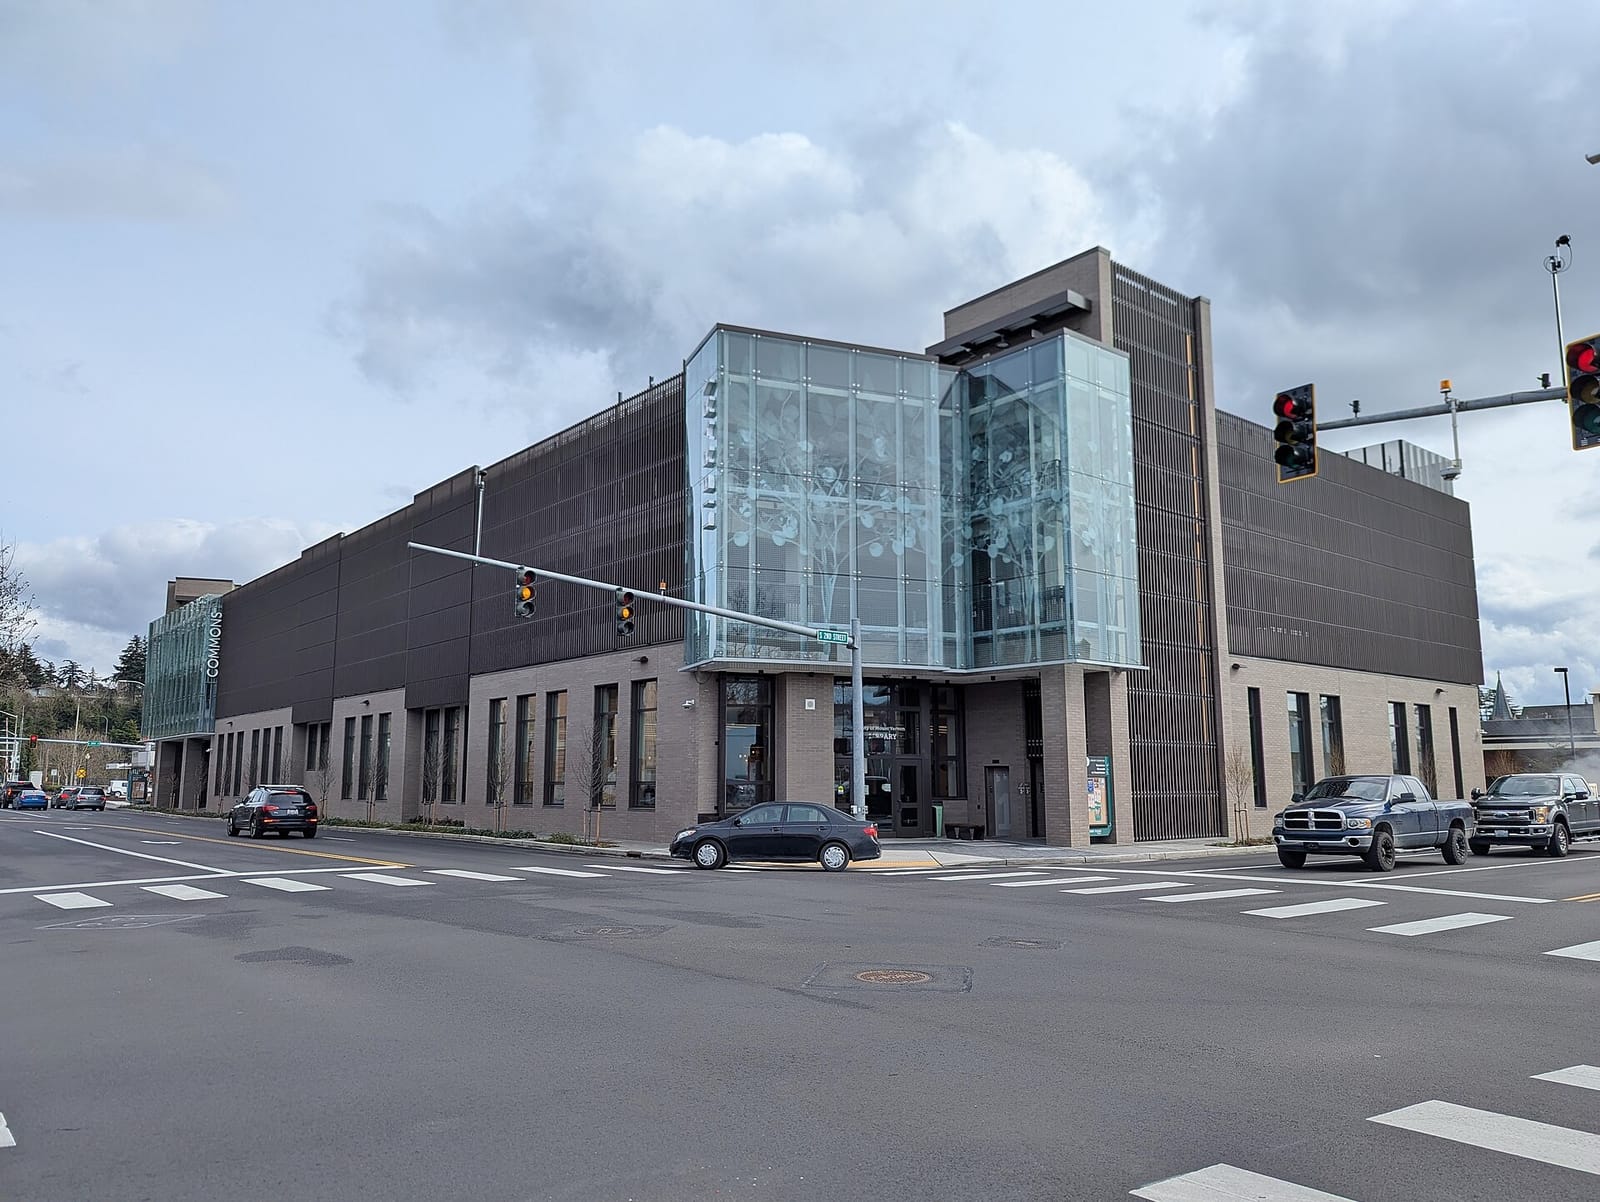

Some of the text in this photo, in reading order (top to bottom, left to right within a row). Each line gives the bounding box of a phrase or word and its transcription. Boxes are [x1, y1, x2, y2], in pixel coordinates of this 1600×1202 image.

[206, 611, 223, 678] COMMONS
[819, 631, 847, 642] S 2ND STREET
